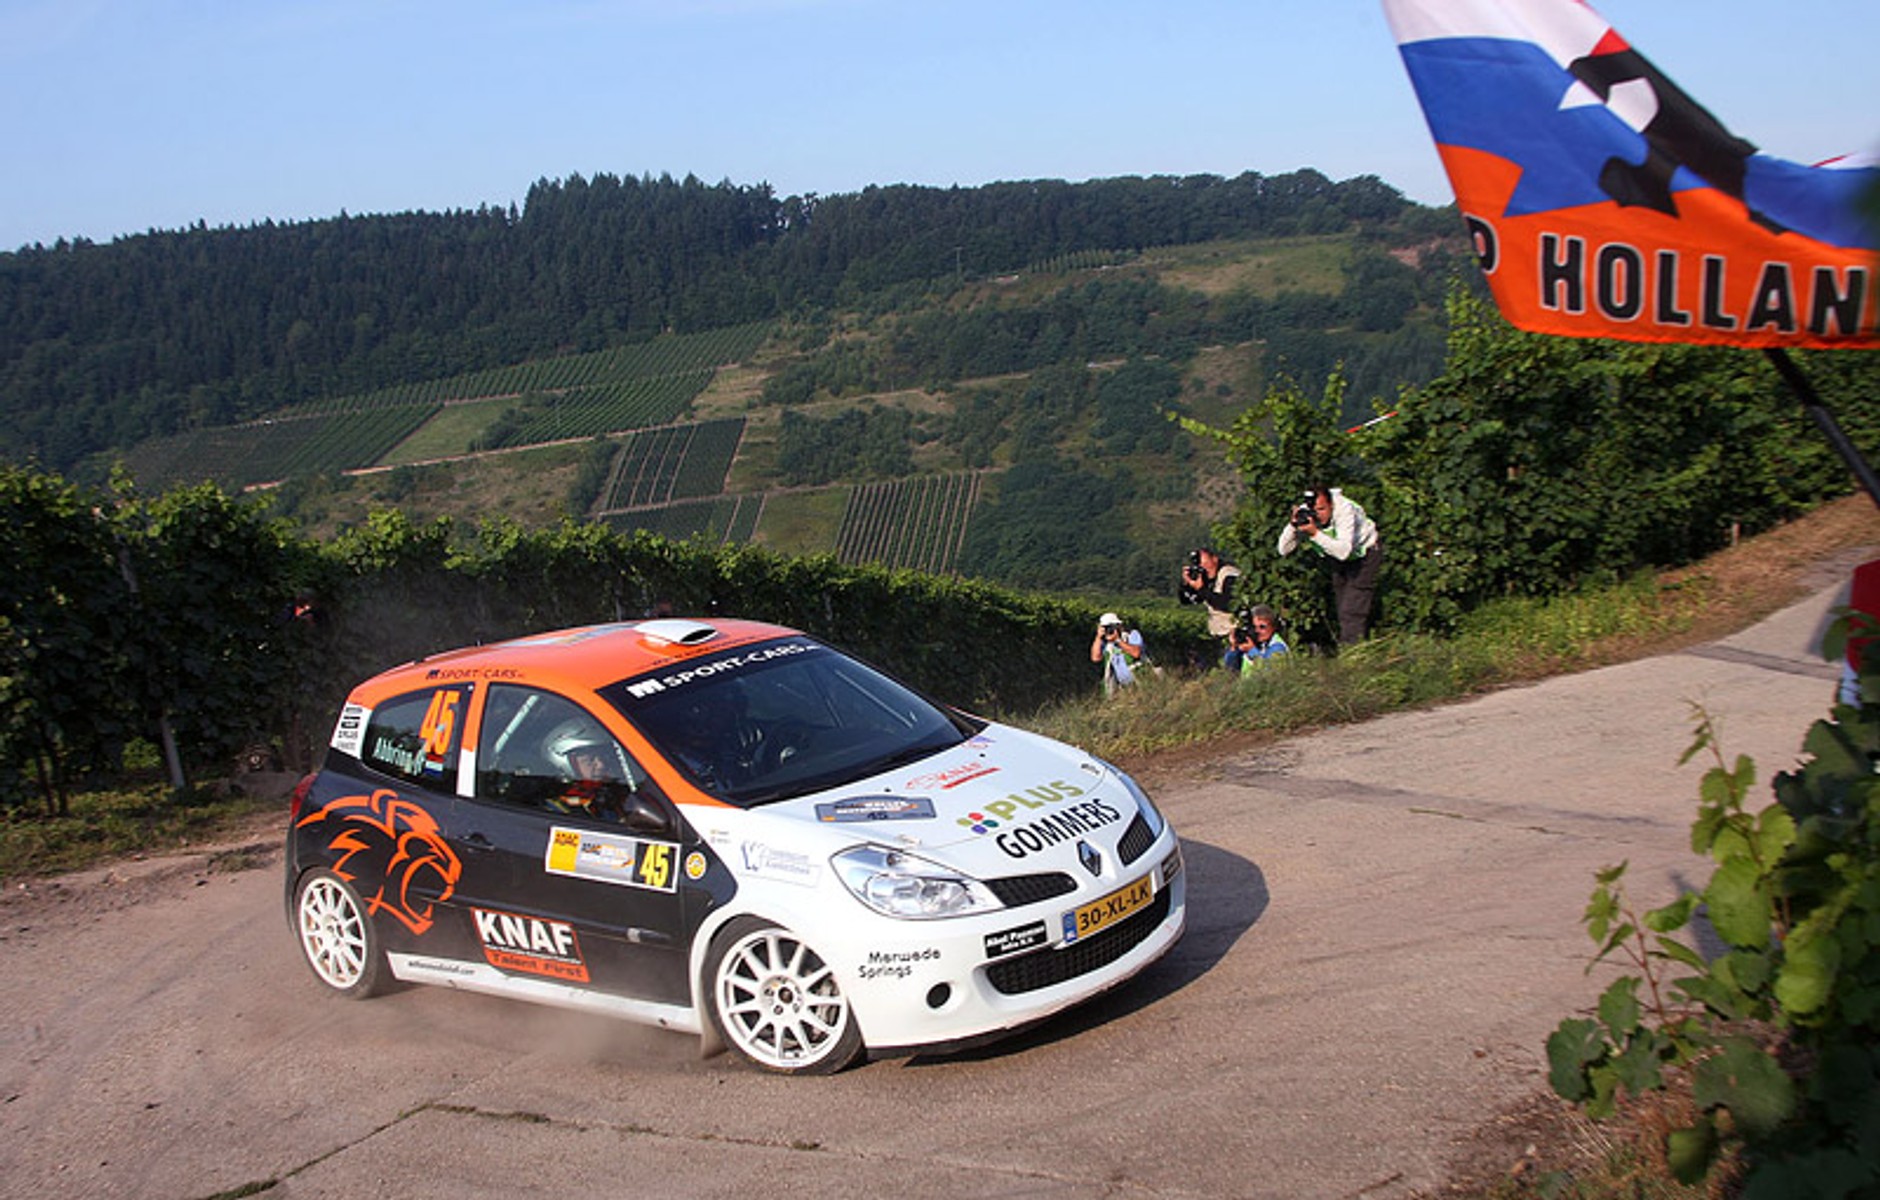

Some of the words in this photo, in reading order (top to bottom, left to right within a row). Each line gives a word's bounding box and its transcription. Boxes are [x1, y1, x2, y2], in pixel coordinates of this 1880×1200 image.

[1539, 232, 1880, 337] HOLLAN
[418, 689, 461, 756] 45
[983, 780, 1085, 821] PLUS
[995, 798, 1122, 859] GOMMERS
[638, 843, 670, 889] 45
[1079, 880, 1149, 932] 30-XL-LK
[474, 908, 574, 956] KNAF
[867, 947, 941, 964] Merwede
[542, 961, 583, 978] First
[857, 964, 913, 981] Springs
